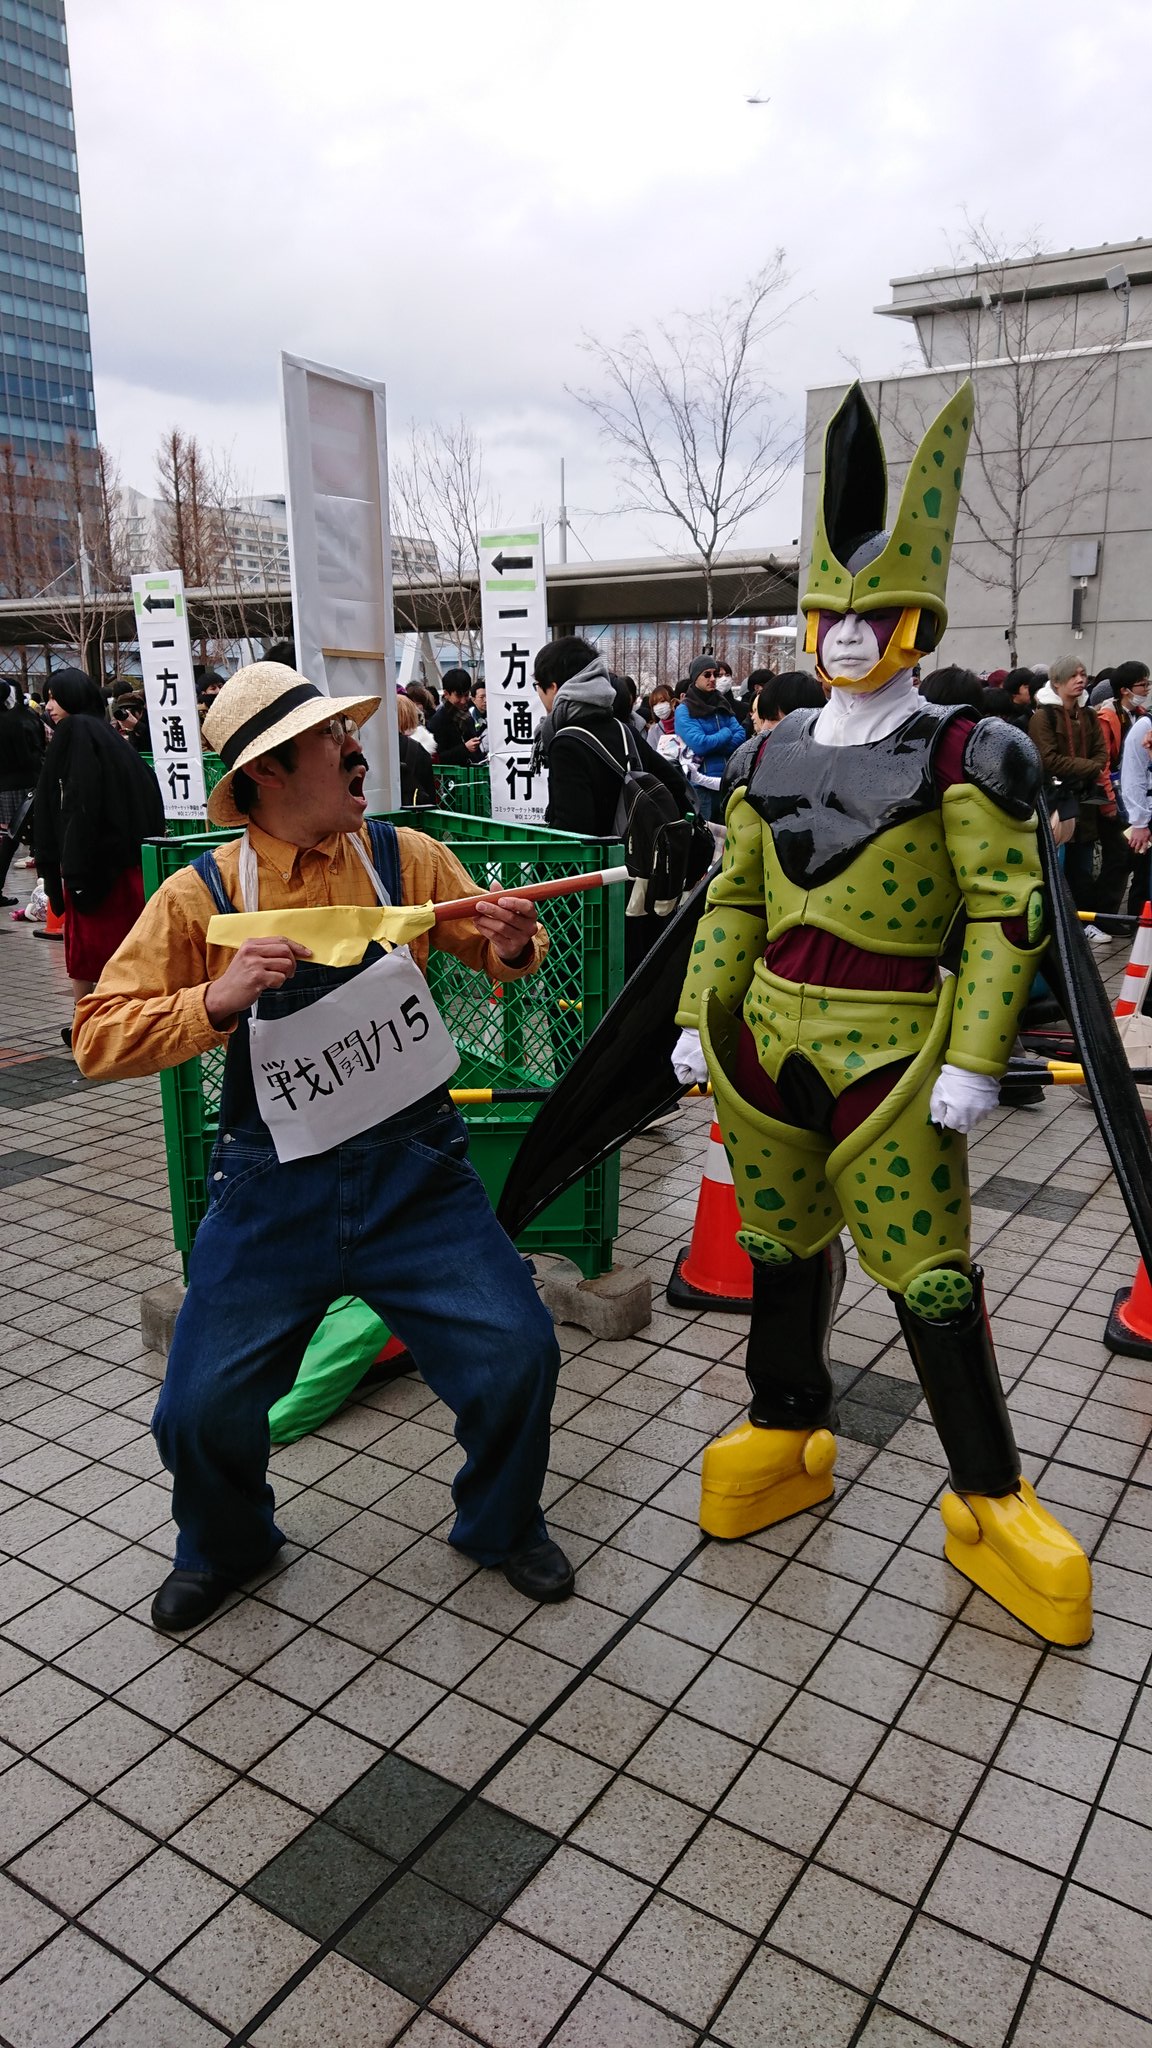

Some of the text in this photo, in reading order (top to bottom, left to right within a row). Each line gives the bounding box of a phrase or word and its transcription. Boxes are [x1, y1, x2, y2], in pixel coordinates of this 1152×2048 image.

[152, 639, 191, 800] 一方通行
[498, 608, 534, 800] 一方通行
[261, 994, 430, 1111] 戦闘力5
